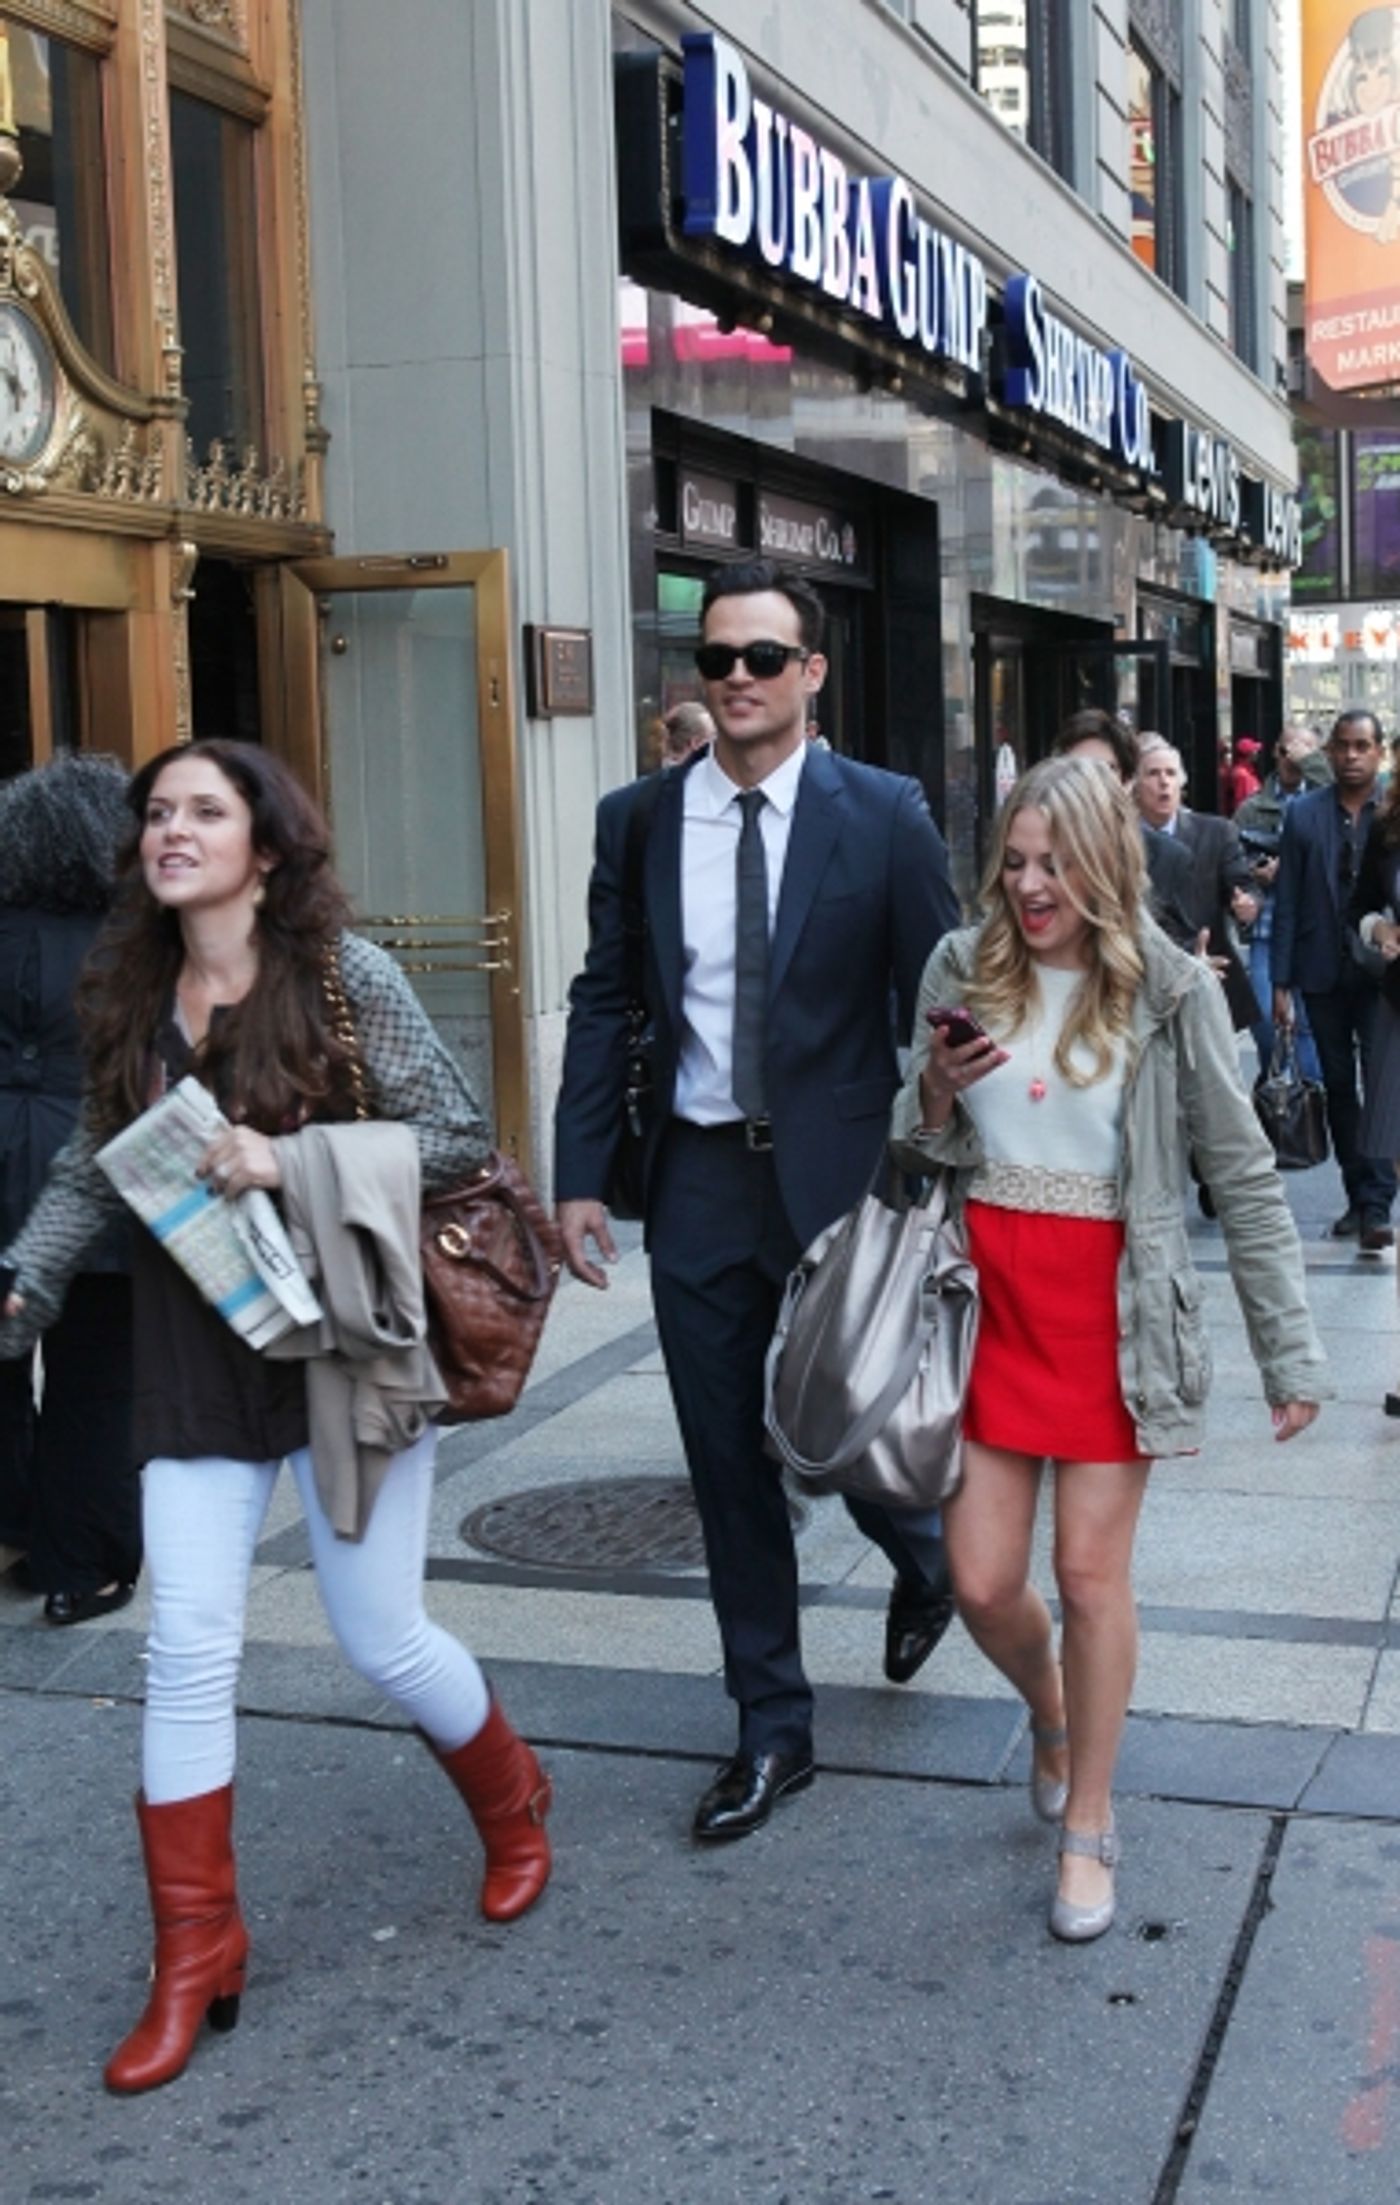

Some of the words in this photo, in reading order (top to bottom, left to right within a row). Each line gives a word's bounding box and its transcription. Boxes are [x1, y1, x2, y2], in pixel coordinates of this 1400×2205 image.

[711, 33, 883, 322] BUBBA
[887, 174, 988, 374] GUMP
[1023, 274, 1116, 450] SHRIMP
[1313, 117, 1387, 175] BUBBA
